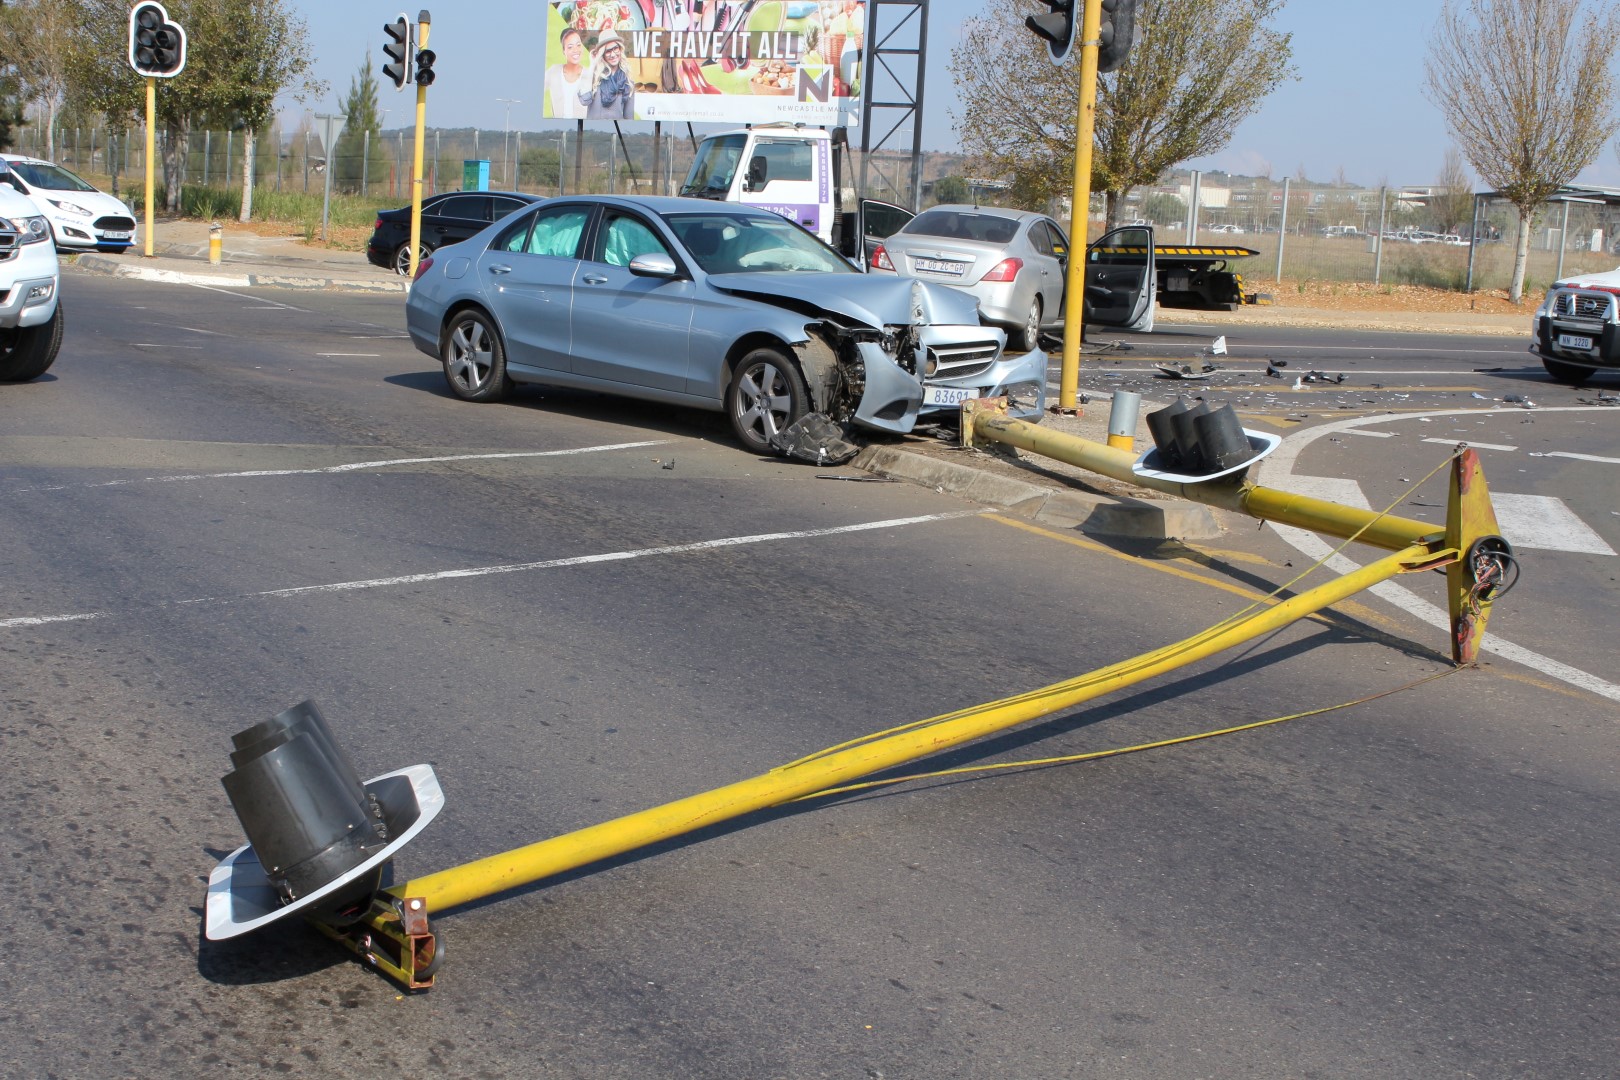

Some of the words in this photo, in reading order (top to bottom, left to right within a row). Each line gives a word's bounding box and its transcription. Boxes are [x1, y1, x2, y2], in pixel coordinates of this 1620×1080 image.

[632, 31, 662, 58] WE
[669, 31, 724, 59] HAVE
[731, 31, 752, 59] IT
[757, 31, 796, 59] ALL
[777, 105, 825, 113] NEWCASTLE
[954, 263, 964, 272] GP
[934, 389, 969, 404] 83691
